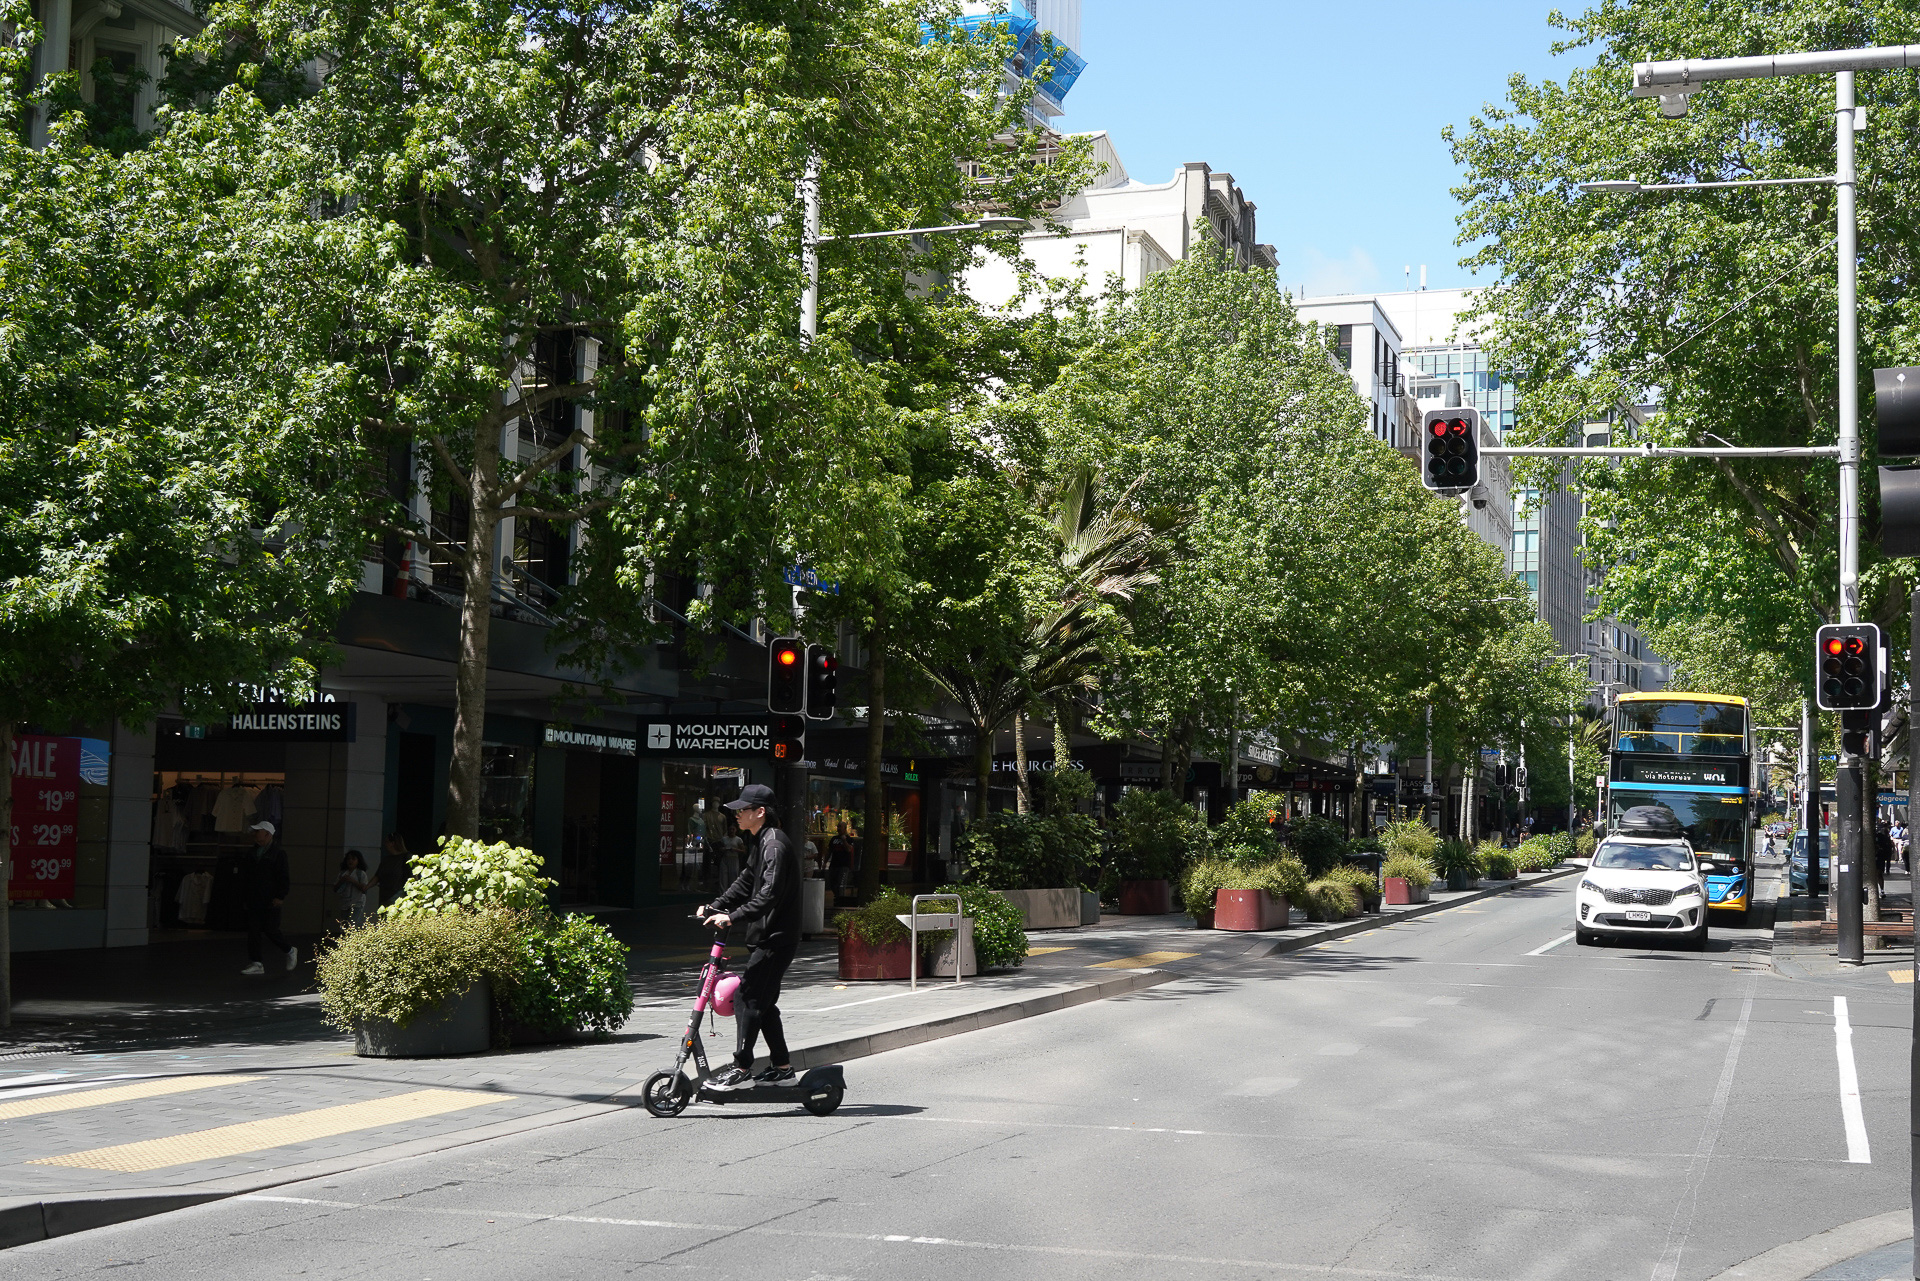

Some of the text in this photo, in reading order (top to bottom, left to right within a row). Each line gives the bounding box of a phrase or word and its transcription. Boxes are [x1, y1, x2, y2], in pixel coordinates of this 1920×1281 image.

[232, 714, 341, 730] HALLENSTEINS
[676, 725, 768, 736] MOUNTAIN
[554, 730, 637, 751] MOUNTAIN WARE
[904, 772, 919, 782] ROLEX
[1644, 772, 1656, 780] via
[1657, 773, 1692, 782] Motorway
[39, 791, 75, 811] $19.99
[33, 824, 74, 846] $29.99
[31, 858, 72, 881] $39.99
